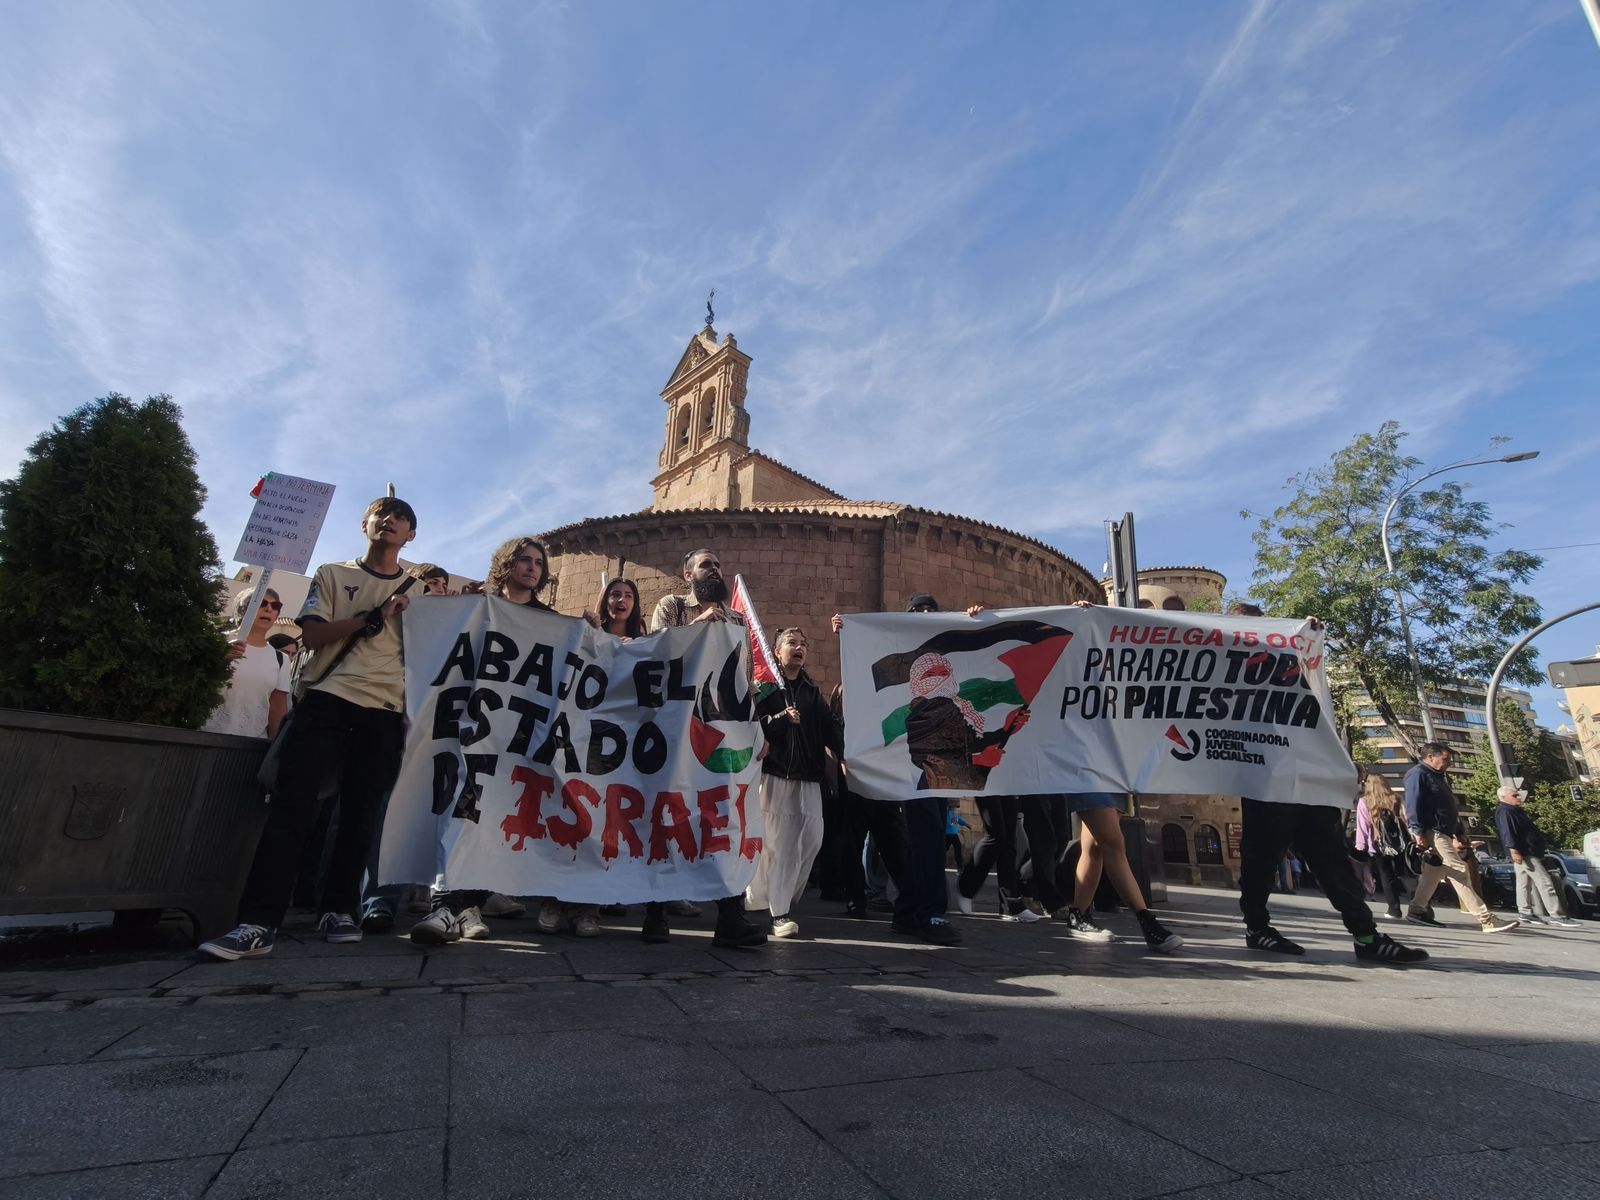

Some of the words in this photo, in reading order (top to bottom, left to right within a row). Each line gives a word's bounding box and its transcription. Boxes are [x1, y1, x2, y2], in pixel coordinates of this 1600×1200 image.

[287, 494, 307, 503] FUEGO
[245, 534, 254, 543] LA
[256, 537, 275, 547] HAYA
[281, 530, 299, 540] GAZA
[1109, 625, 1224, 647] HUELGA
[1232, 630, 1259, 648] 15
[1266, 632, 1316, 654] OCT
[430, 630, 608, 710] ABAJO
[633, 658, 696, 708] EL
[1083, 648, 1217, 682] PARARLO
[1224, 650, 1312, 691] TOD
[1060, 685, 1118, 720] POR
[1124, 686, 1322, 729] PALESTINA
[432, 686, 668, 775] ESTADO
[1205, 728, 1290, 748] COORDINADORA
[1205, 739, 1248, 753] JUVENIL
[1206, 749, 1266, 766] SOCIALISTA
[431, 752, 498, 824] DE
[501, 765, 763, 866] ISRAEL
